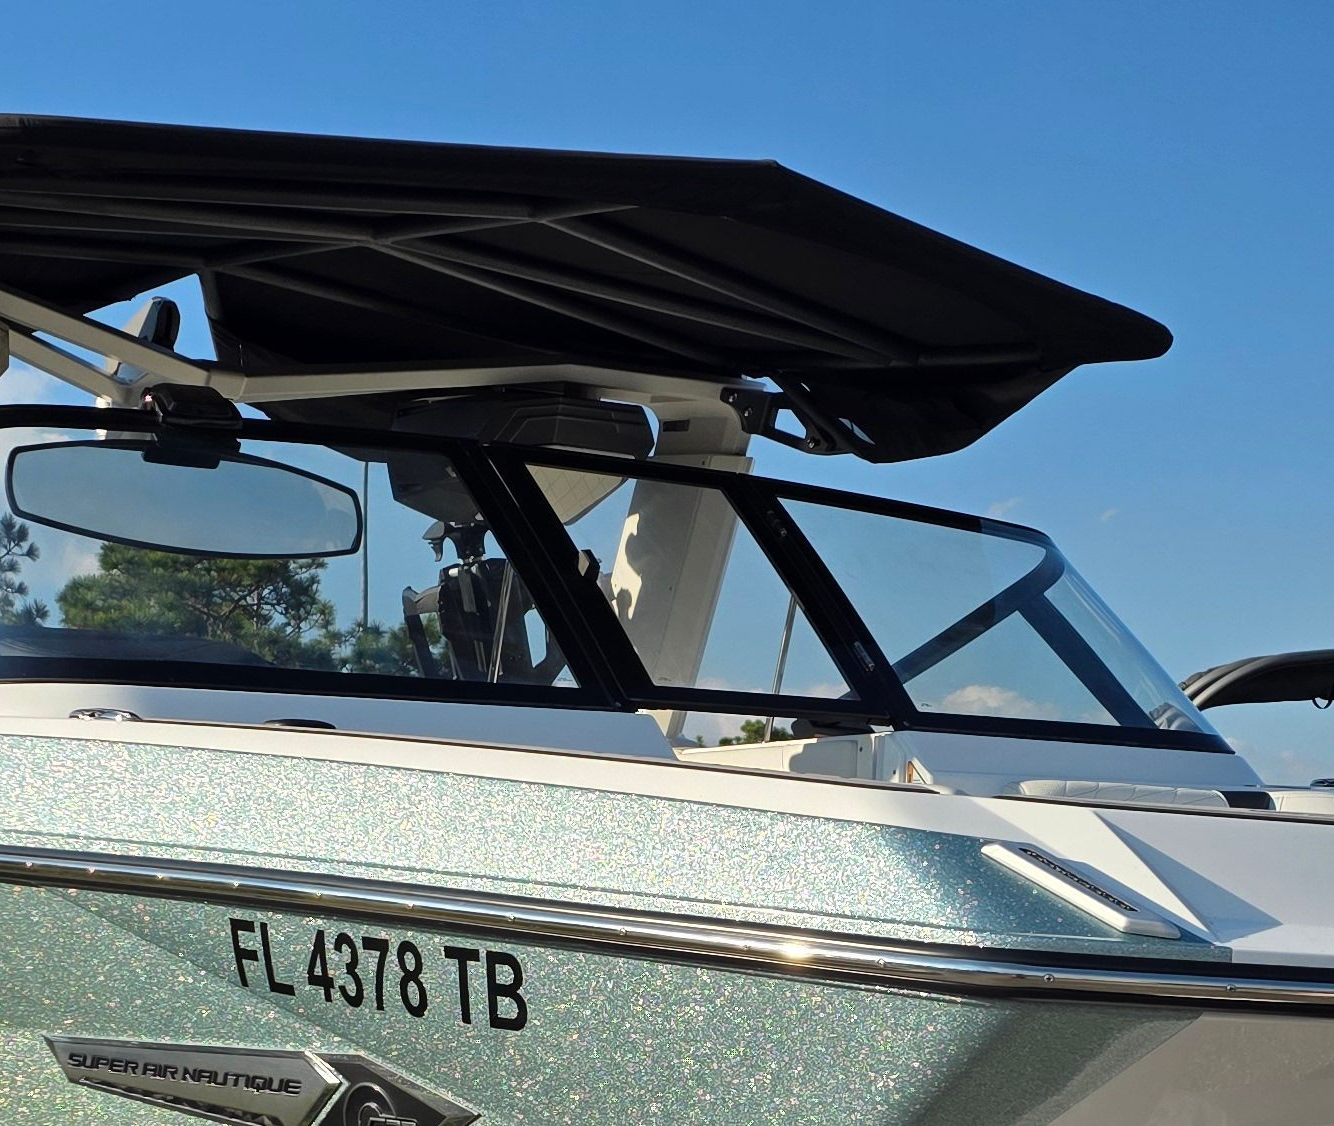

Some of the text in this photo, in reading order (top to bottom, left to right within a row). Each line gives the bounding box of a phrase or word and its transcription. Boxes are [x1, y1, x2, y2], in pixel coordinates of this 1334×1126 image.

[229, 917, 529, 1032] FL 4378 TB
[67, 1052, 303, 1096] SUPER AIR NAUTIQUE
